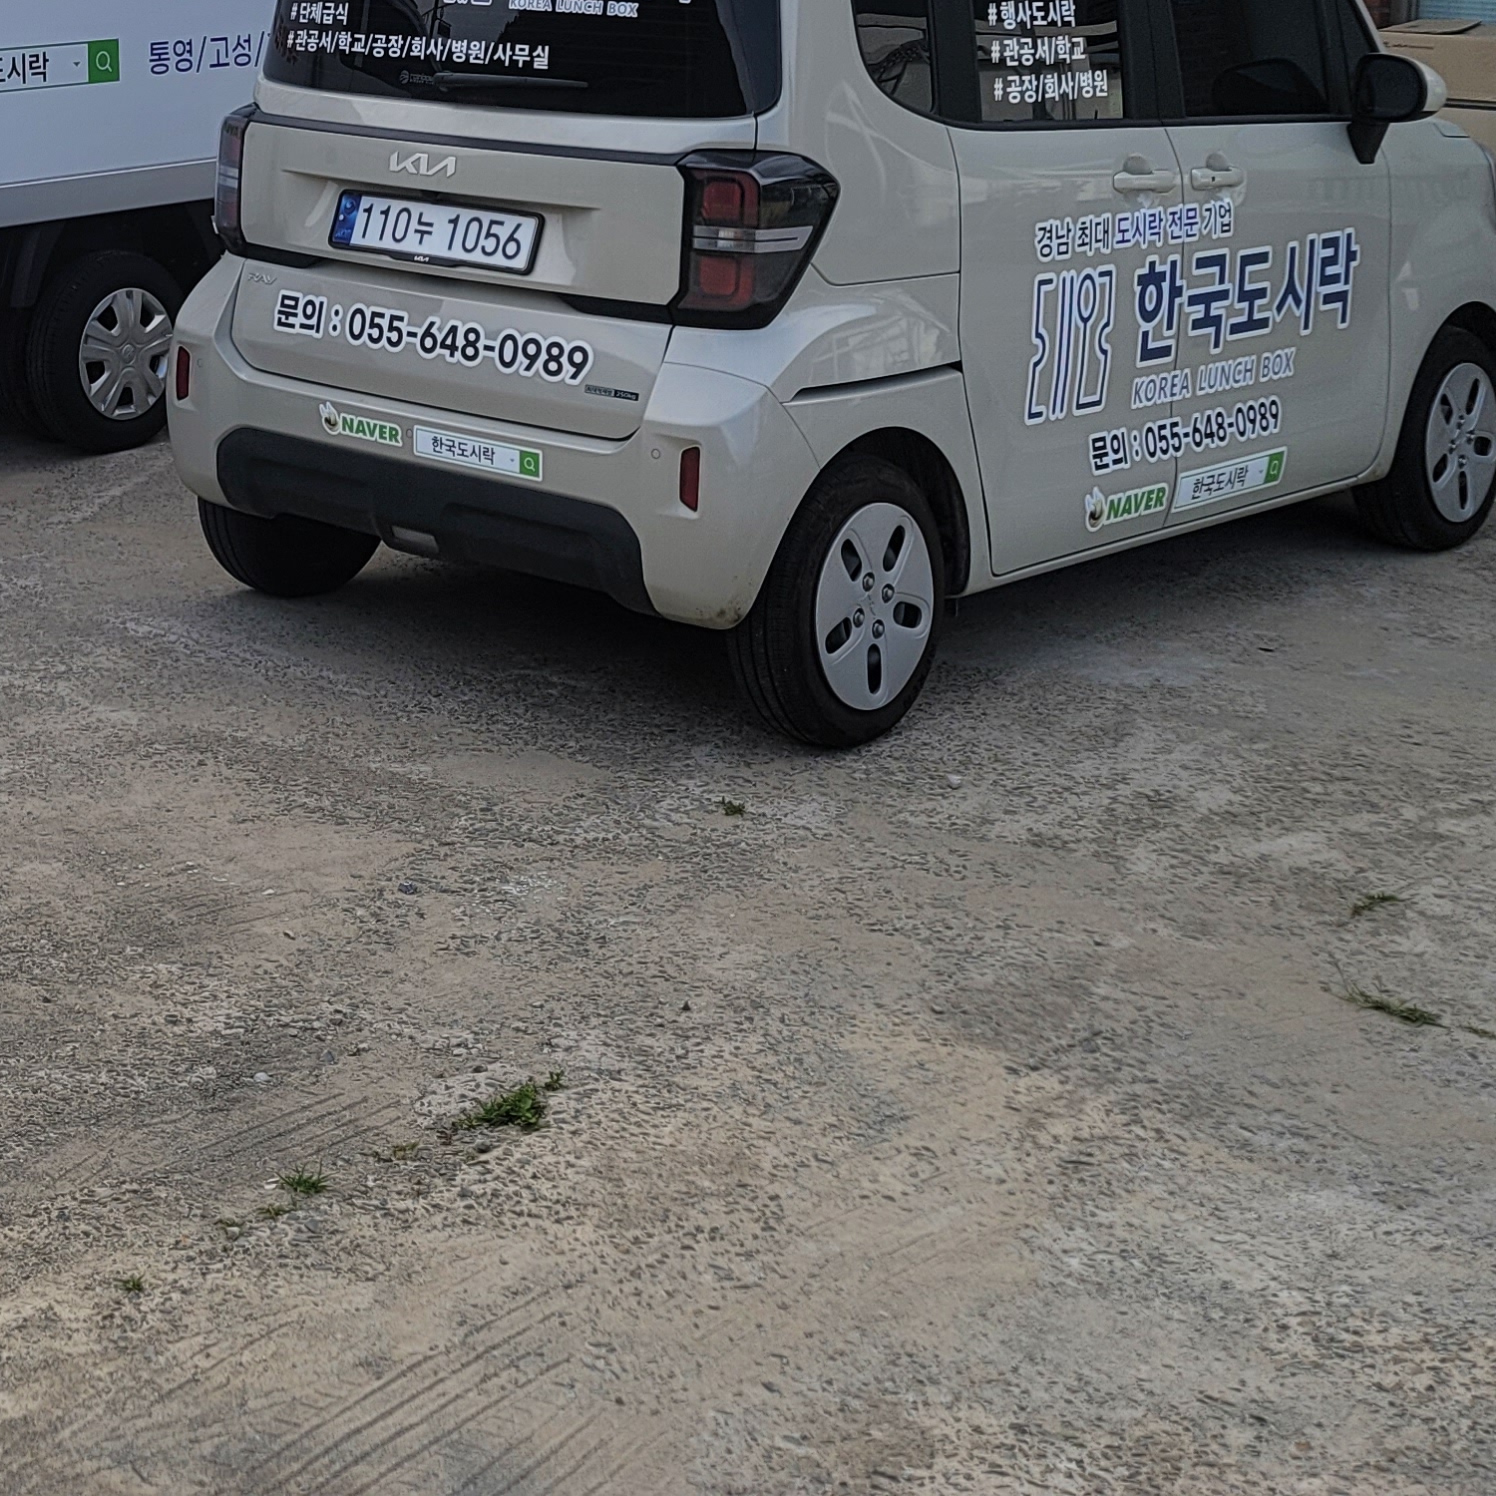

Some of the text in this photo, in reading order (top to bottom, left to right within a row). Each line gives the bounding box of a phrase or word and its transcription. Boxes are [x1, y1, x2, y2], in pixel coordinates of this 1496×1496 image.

[607, 1, 638, 17] BOX
[361, 202, 524, 261] 110누 1056
[1036, 200, 1234, 259] 경남 최대 도시락 전문 기업
[1136, 231, 1359, 364] 한국도시락
[348, 306, 590, 381] 055-648-0989
[1132, 349, 1296, 405] KOREA LUNCH BOX
[341, 414, 402, 444] NAVER
[431, 433, 496, 466] 한국도시락
[1144, 398, 1280, 460] 055-648-0989
[1106, 486, 1167, 521] NAVER
[1191, 465, 1249, 500] 한국도시락
